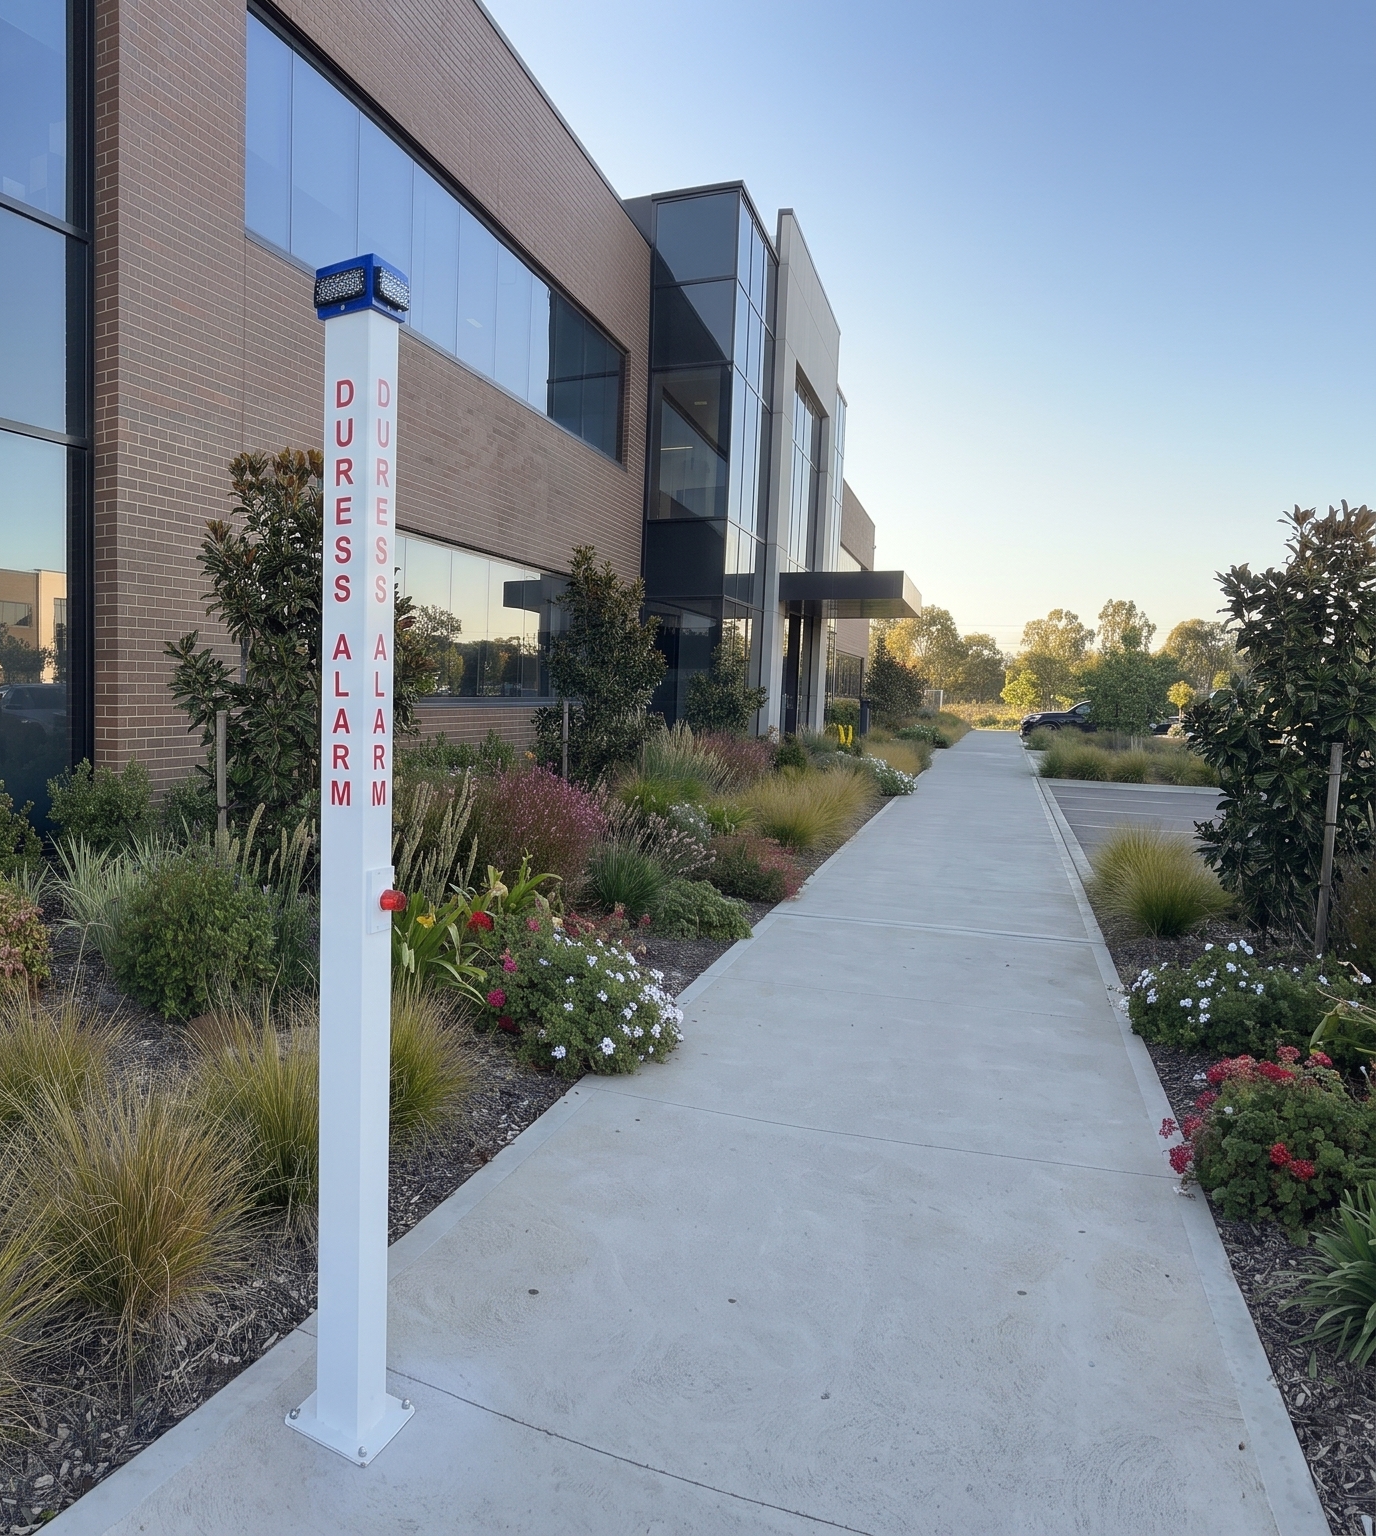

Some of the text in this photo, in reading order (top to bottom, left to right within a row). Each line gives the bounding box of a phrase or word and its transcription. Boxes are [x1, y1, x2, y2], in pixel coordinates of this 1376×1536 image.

[330, 378, 355, 807] DURESS ALARM
[372, 378, 390, 806] DURESS ALARM
